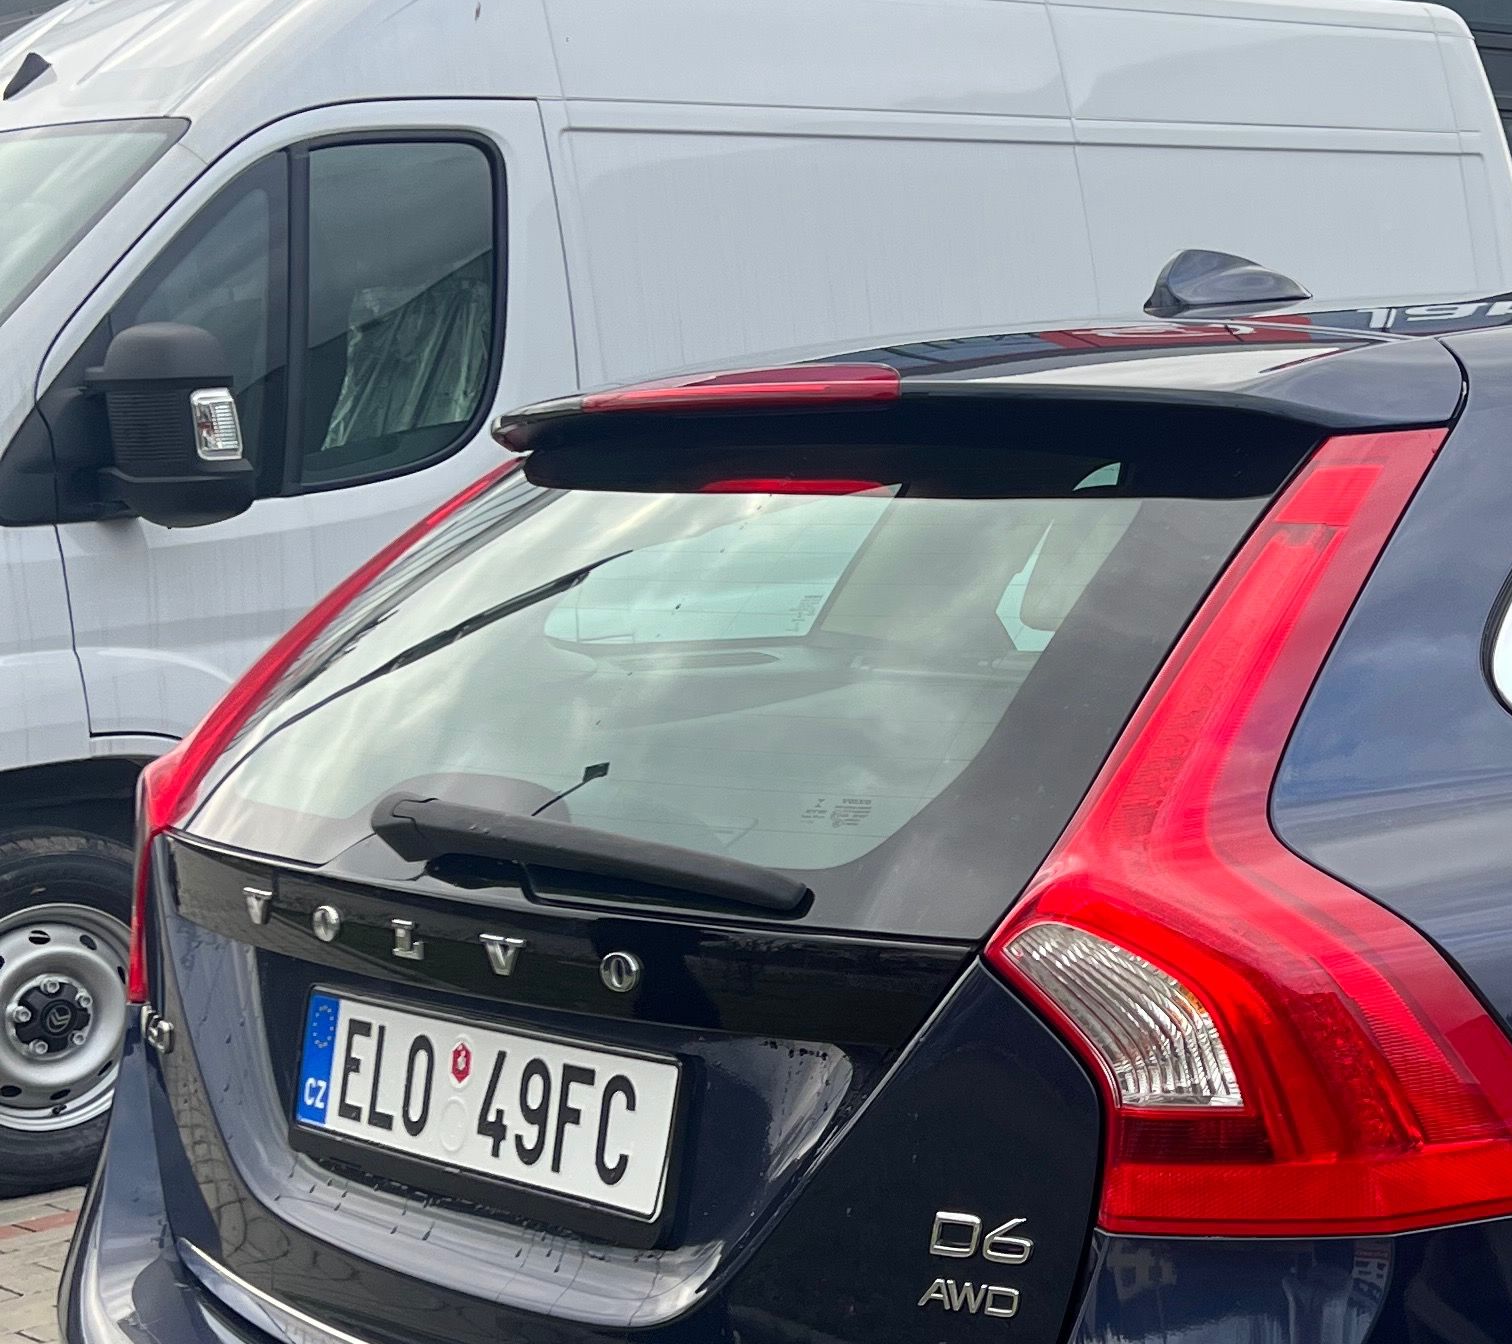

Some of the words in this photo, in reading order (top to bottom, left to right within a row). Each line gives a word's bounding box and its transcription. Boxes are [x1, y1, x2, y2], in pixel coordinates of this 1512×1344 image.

[243, 886, 641, 993] VOLVO
[304, 1076, 327, 1109] CZ
[476, 1050, 637, 1186] 49FC
[929, 1211, 1034, 1265] D6
[917, 1278, 1020, 1318] AWD
